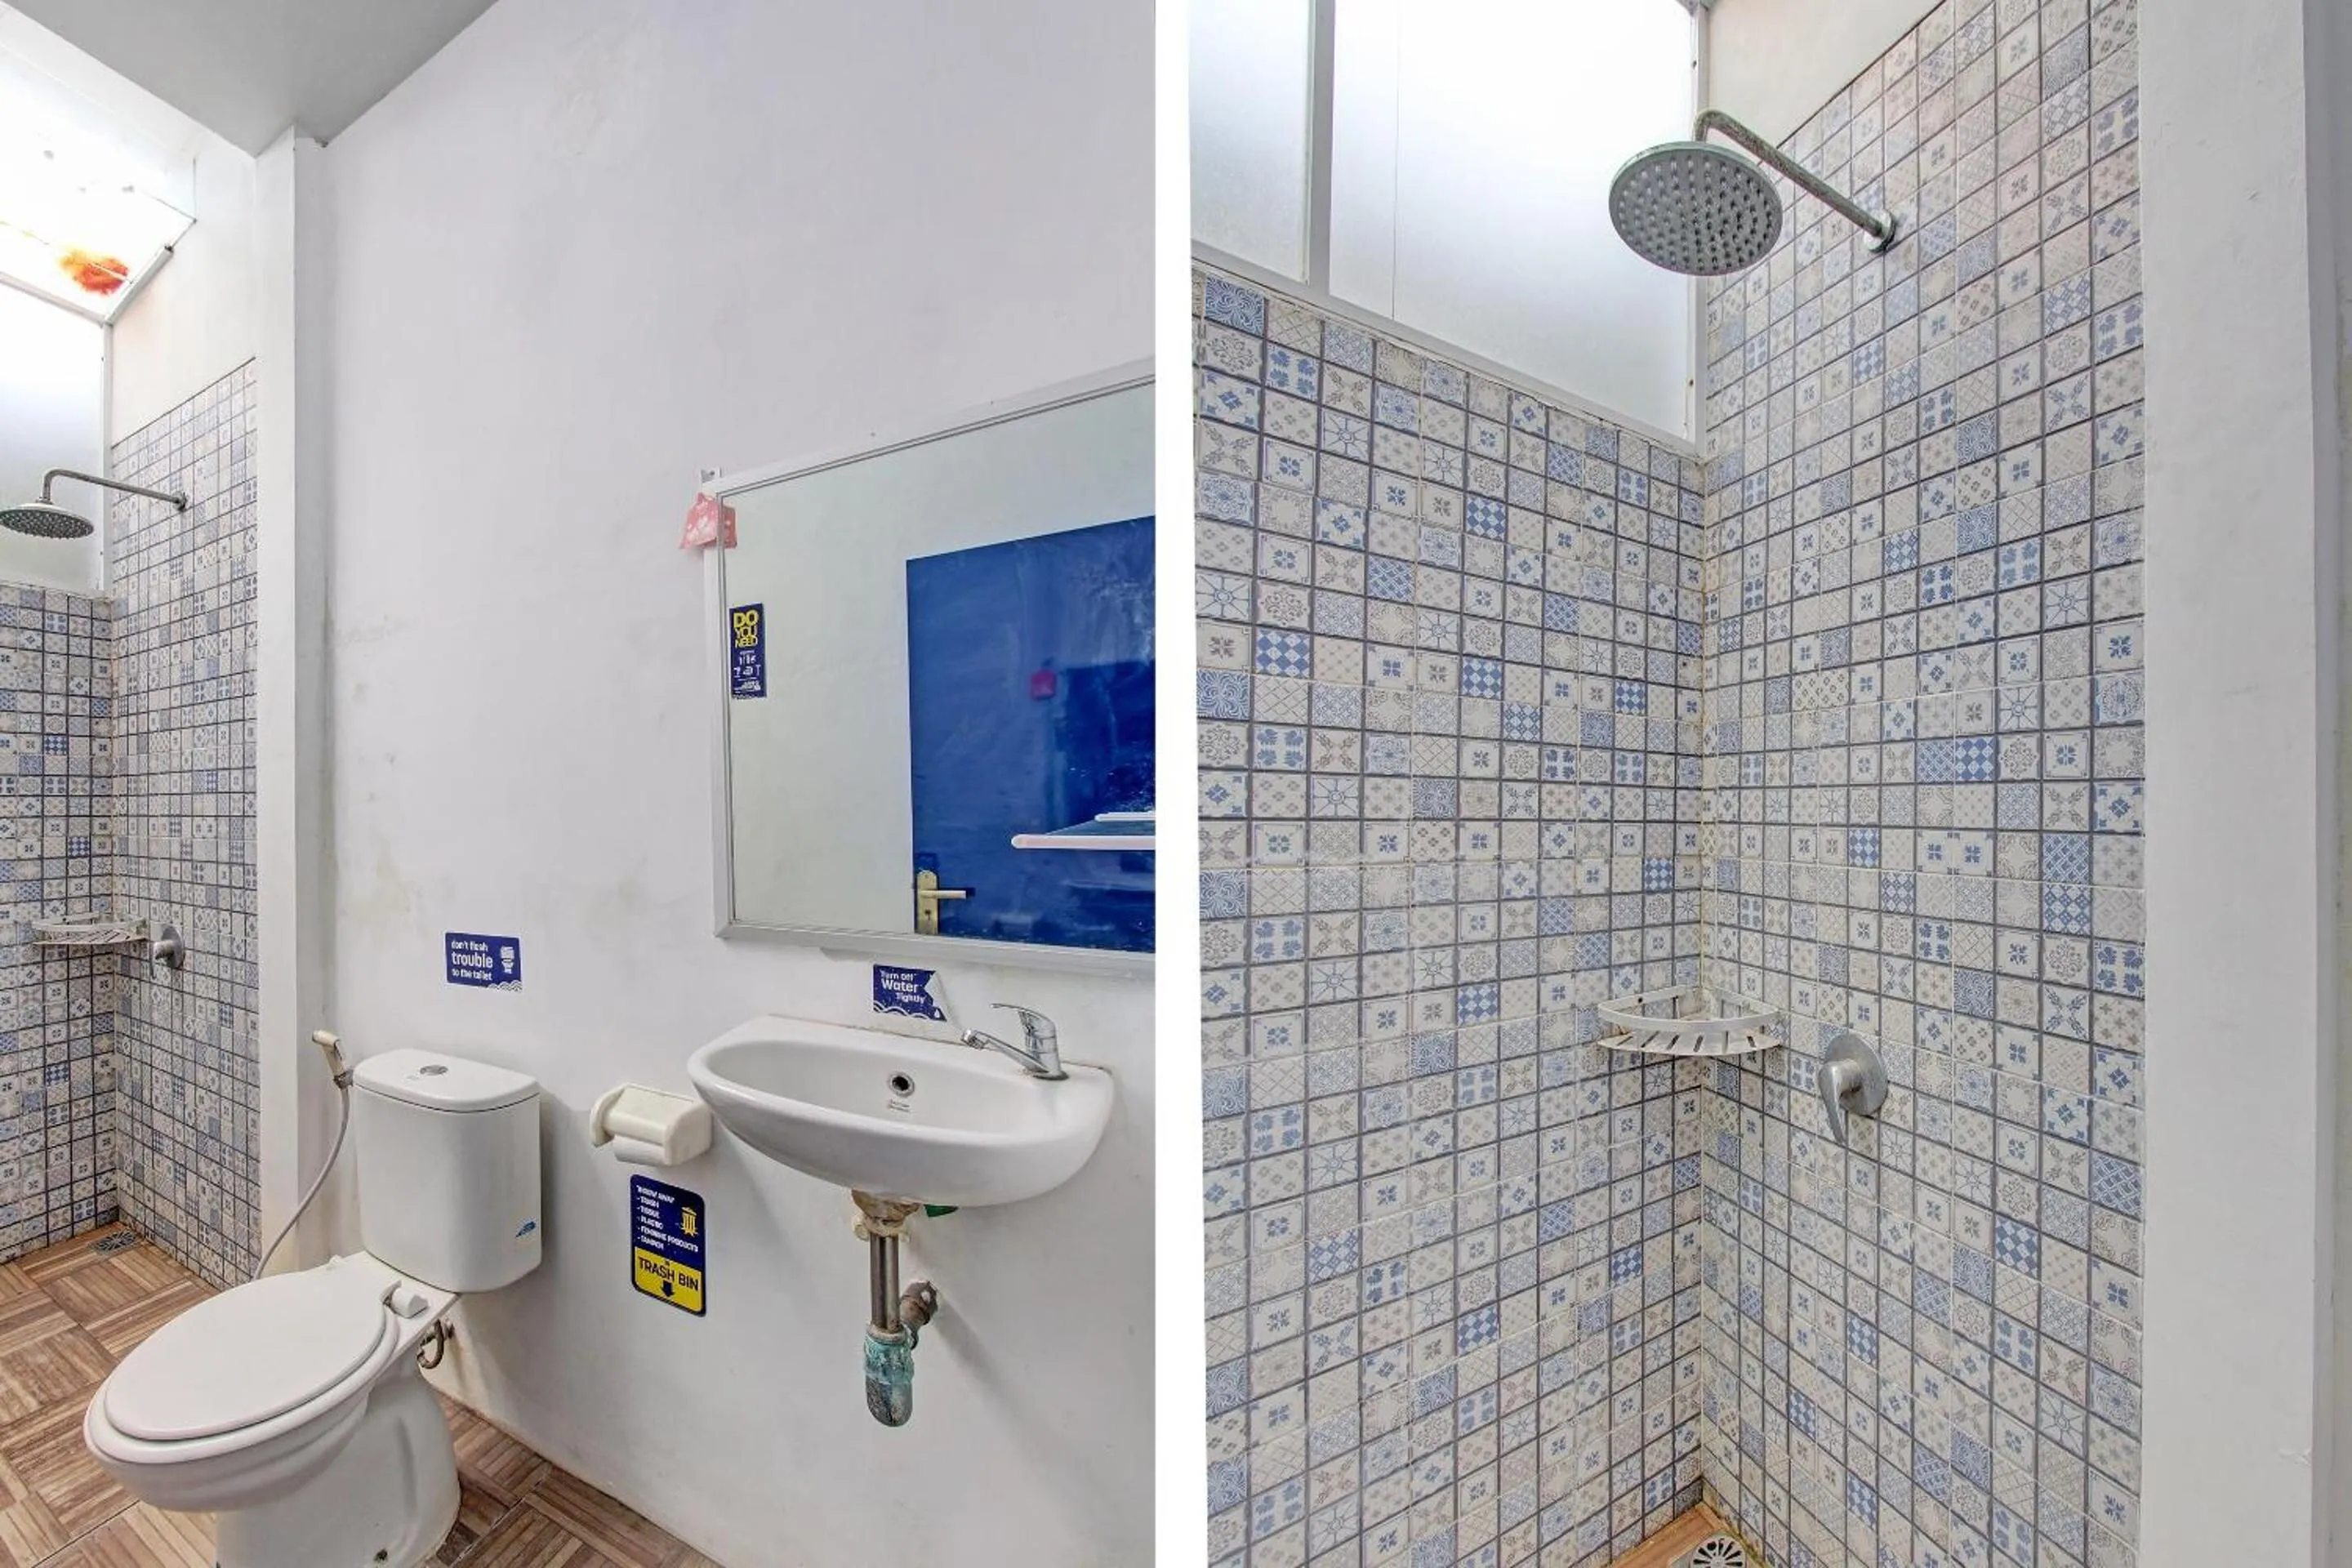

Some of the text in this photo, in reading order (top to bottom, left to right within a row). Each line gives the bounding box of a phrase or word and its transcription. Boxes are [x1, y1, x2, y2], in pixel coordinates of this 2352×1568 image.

[733, 610, 759, 628] DO
[735, 625, 758, 638] YOU
[735, 635, 758, 648] NEED
[452, 951, 493, 968] trouble
[881, 978, 919, 993] Water
[639, 1255, 698, 1291] TRASH BIN
